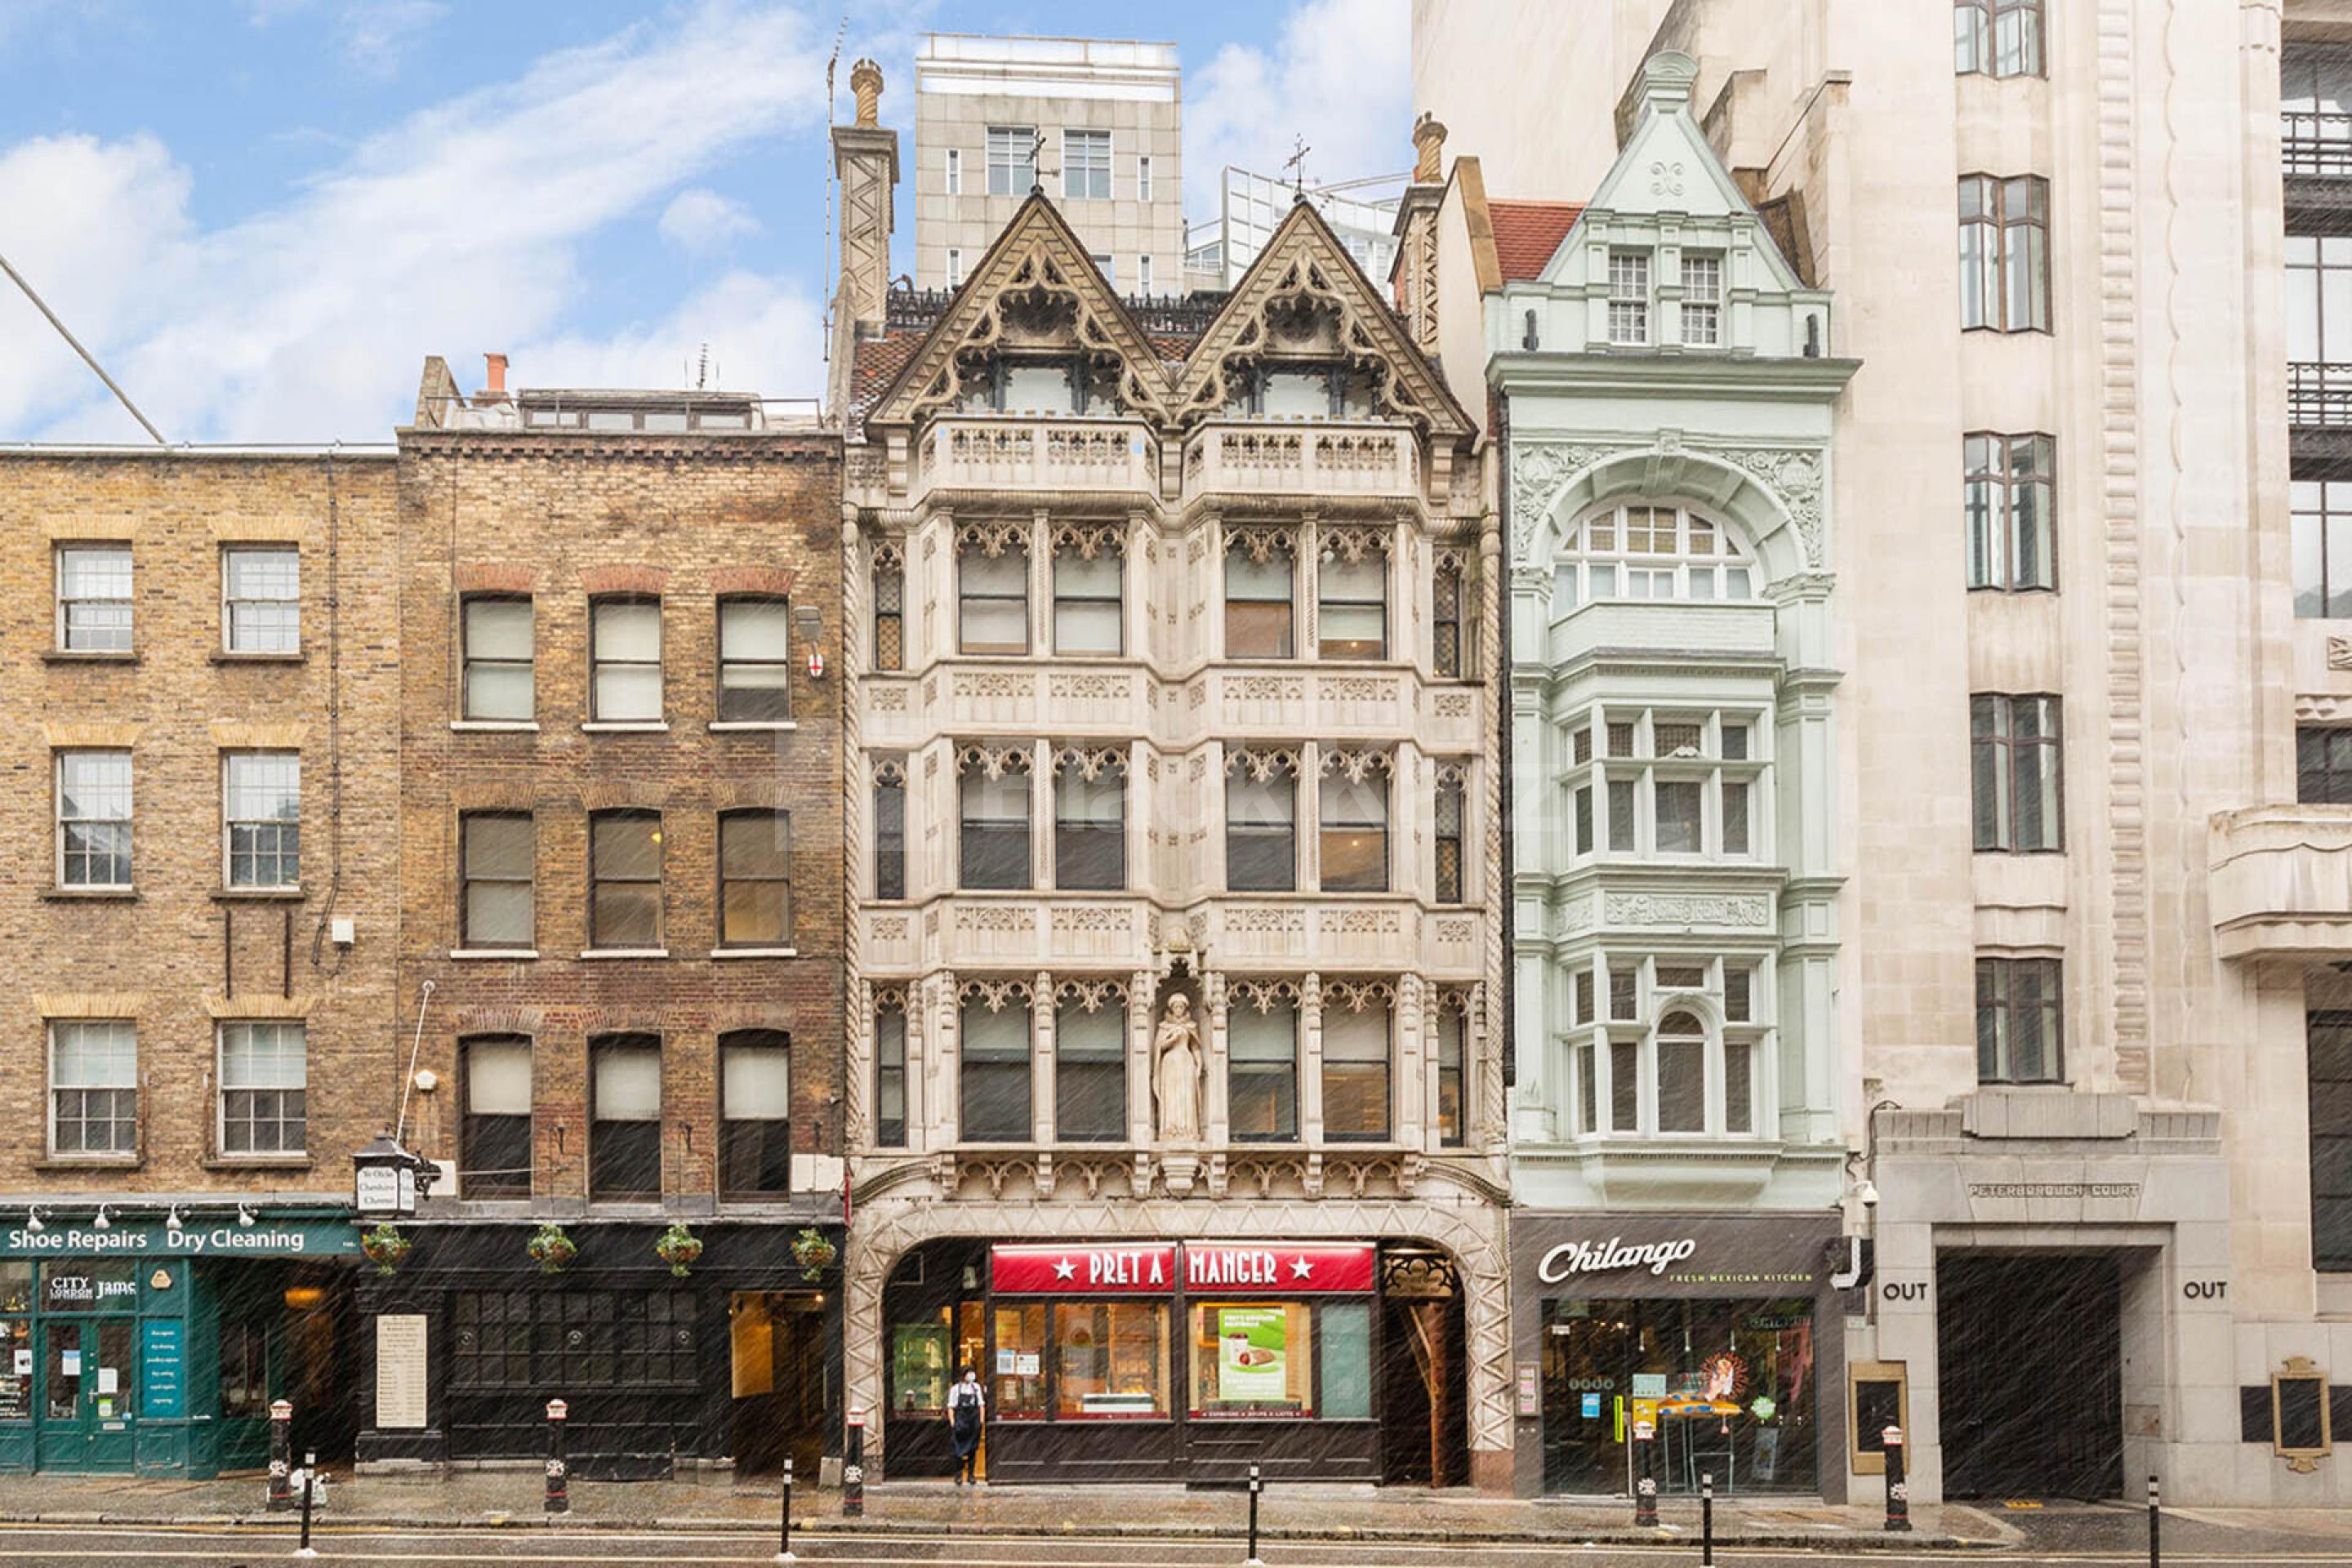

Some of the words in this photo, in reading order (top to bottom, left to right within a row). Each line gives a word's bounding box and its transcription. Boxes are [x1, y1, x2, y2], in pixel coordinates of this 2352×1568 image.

[1969, 1183, 2082, 1198] PETERBOROUGH
[2090, 1183, 2140, 1198] COURT
[9, 1229, 63, 1249] Shoe
[68, 1229, 148, 1253] Repairs
[167, 1230, 206, 1253] Dry
[211, 1228, 305, 1252] Cleaning
[1089, 1251, 1142, 1285] PRET
[1148, 1251, 1164, 1285] A
[1189, 1251, 1277, 1285] MANGER
[1538, 1236, 1696, 1284] Chilango
[51, 1276, 89, 1289] CITY
[1668, 1274, 1706, 1282] FRESH
[1710, 1274, 1760, 1282] MEXICAN
[1764, 1274, 1813, 1282] KITCHEN
[1883, 1283, 1928, 1301] OUT
[2184, 1281, 2228, 1299] OUT
